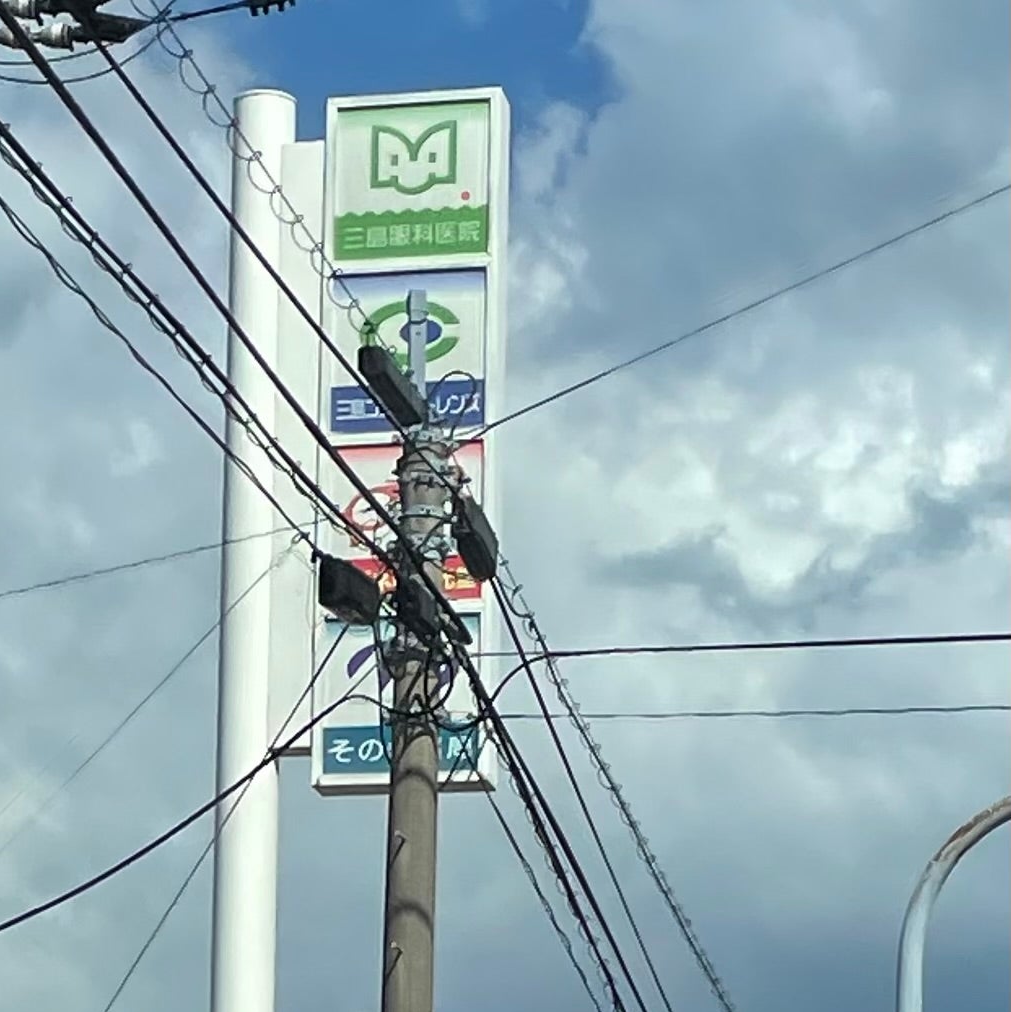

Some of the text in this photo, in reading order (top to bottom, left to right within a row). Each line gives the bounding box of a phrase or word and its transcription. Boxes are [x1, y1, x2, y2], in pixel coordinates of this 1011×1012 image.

[342, 220, 481, 250] 三島眼科医院
